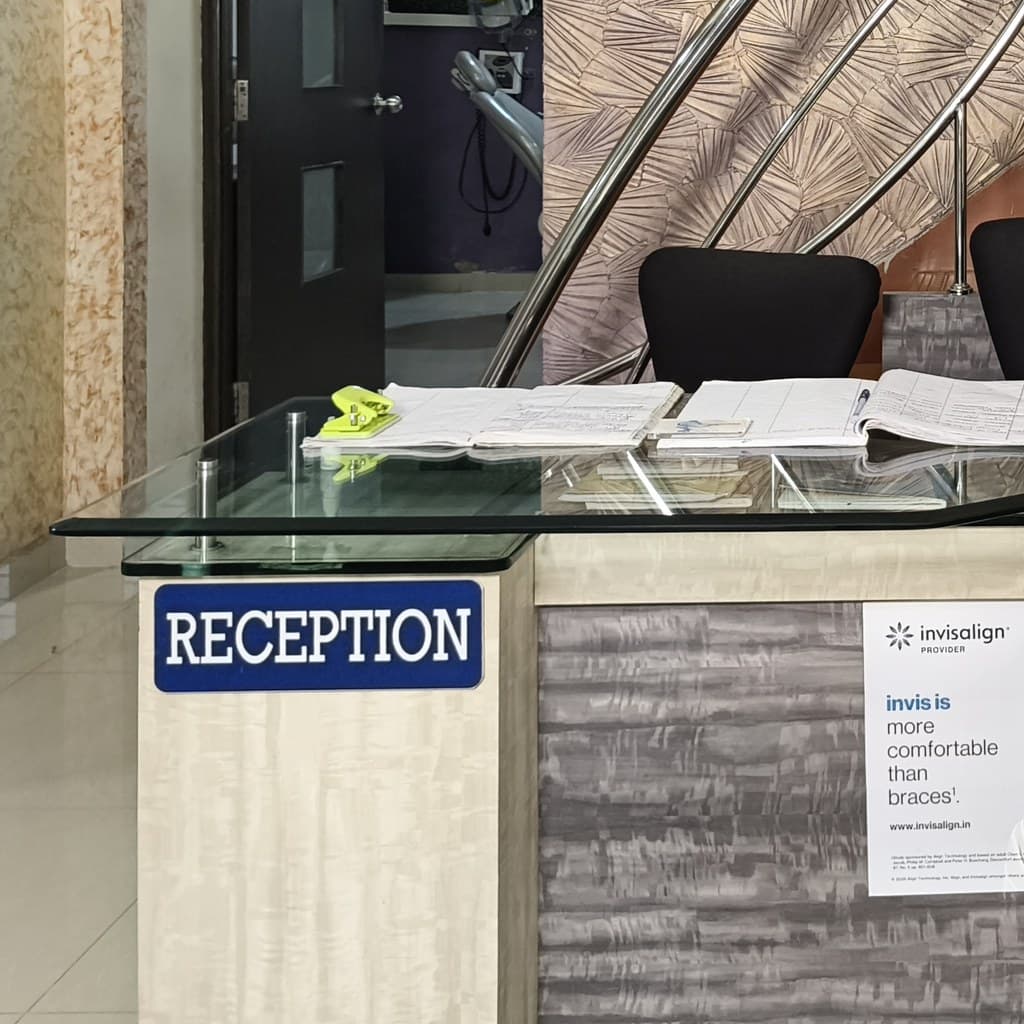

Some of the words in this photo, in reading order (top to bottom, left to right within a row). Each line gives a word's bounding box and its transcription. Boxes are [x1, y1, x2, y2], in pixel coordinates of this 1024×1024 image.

[165, 608, 471, 665] RECEPTION
[920, 623, 1005, 644] invisalign
[920, 645, 966, 654] PROVIDER
[886, 693, 932, 712] invis
[935, 692, 951, 710] is
[887, 720, 935, 735] more
[887, 738, 999, 759] comfortable
[888, 764, 928, 782] than
[889, 819, 971, 831] www.invisalign.in
